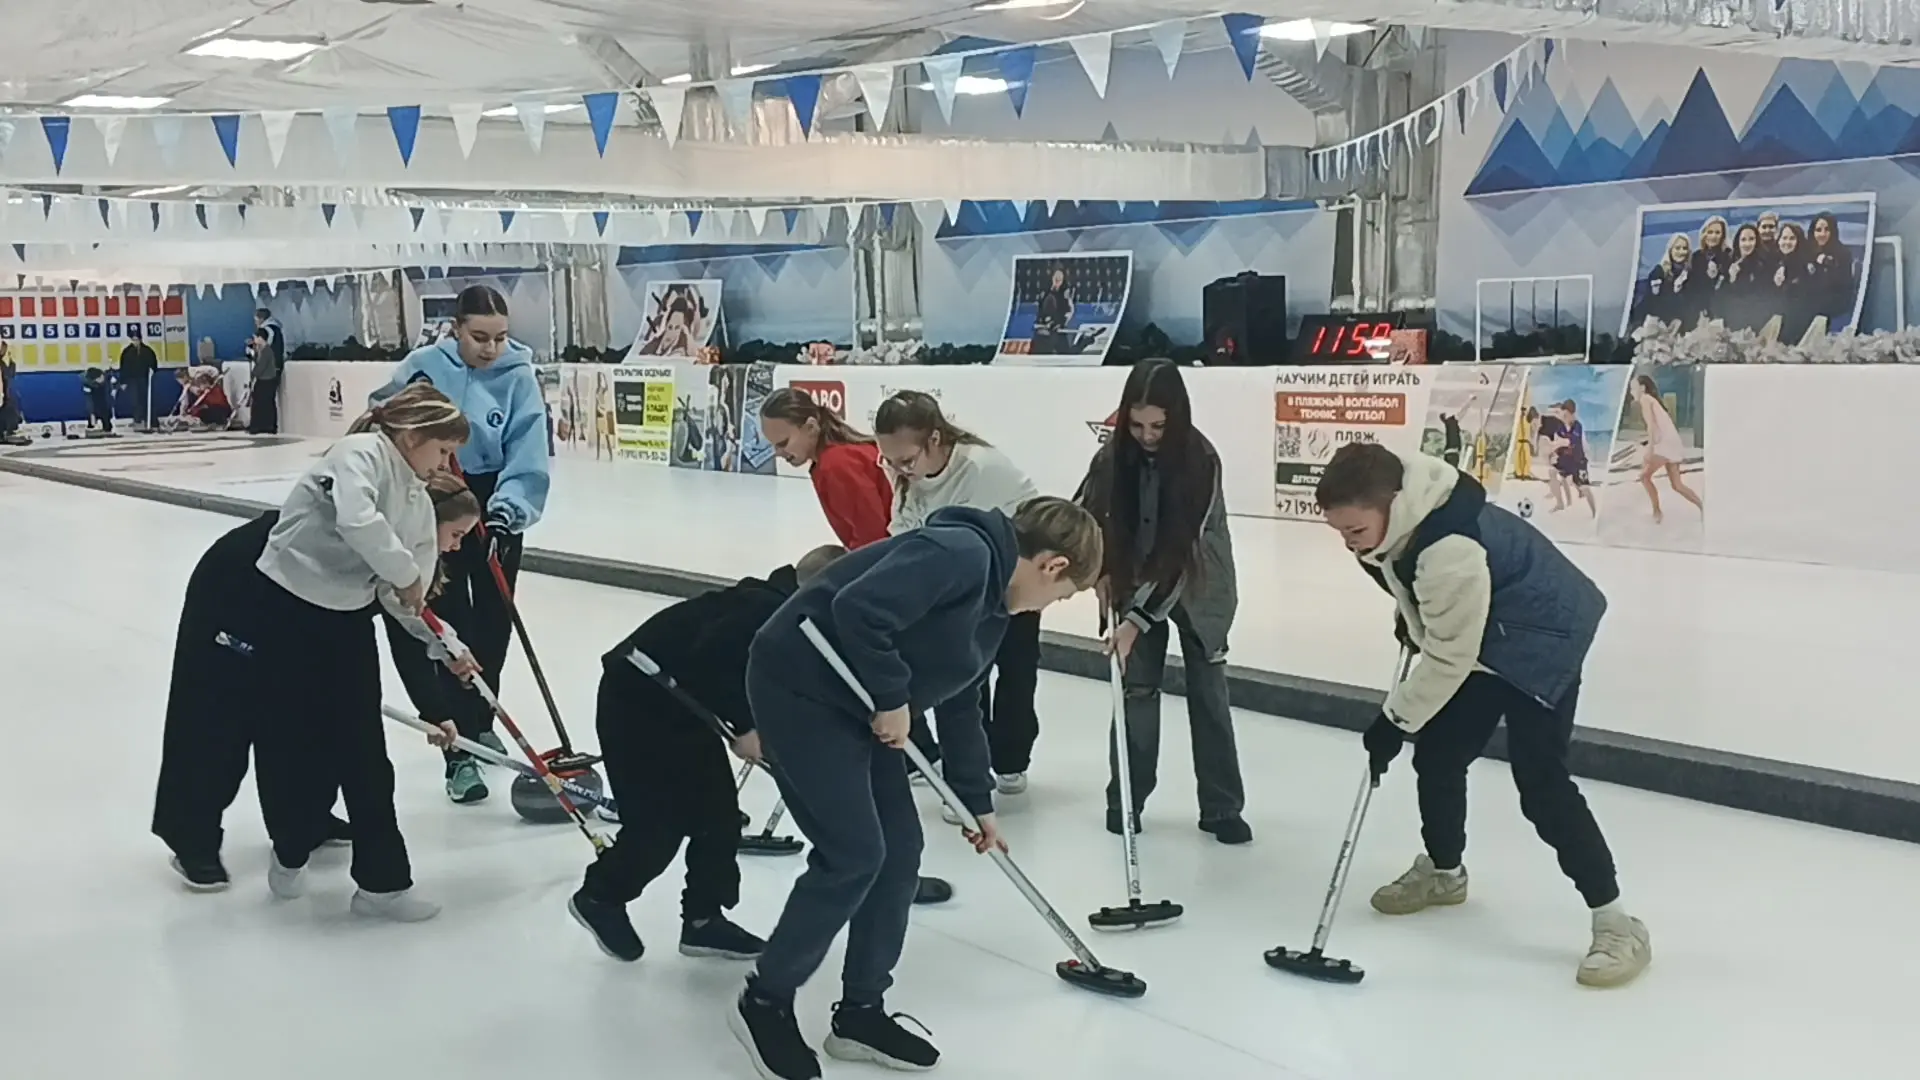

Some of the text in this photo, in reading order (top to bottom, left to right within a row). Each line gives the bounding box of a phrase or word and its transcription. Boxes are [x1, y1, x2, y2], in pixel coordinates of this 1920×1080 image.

[2, 326, 11, 337] 3
[24, 326, 33, 337] 4
[46, 325, 55, 336] 5
[66, 325, 75, 336] 6
[88, 324, 96, 335] 7
[109, 324, 117, 335] 8
[149, 323, 162, 335] 10
[1276, 371, 1420, 387] НАУЧИМ ДЕТЕЙ ИГРАТЬ
[1345, 394, 1399, 408] ВОЛЕЙБОЛ
[1344, 409, 1386, 421] ФУТБОЛ
[1276, 498, 1291, 513] +7
